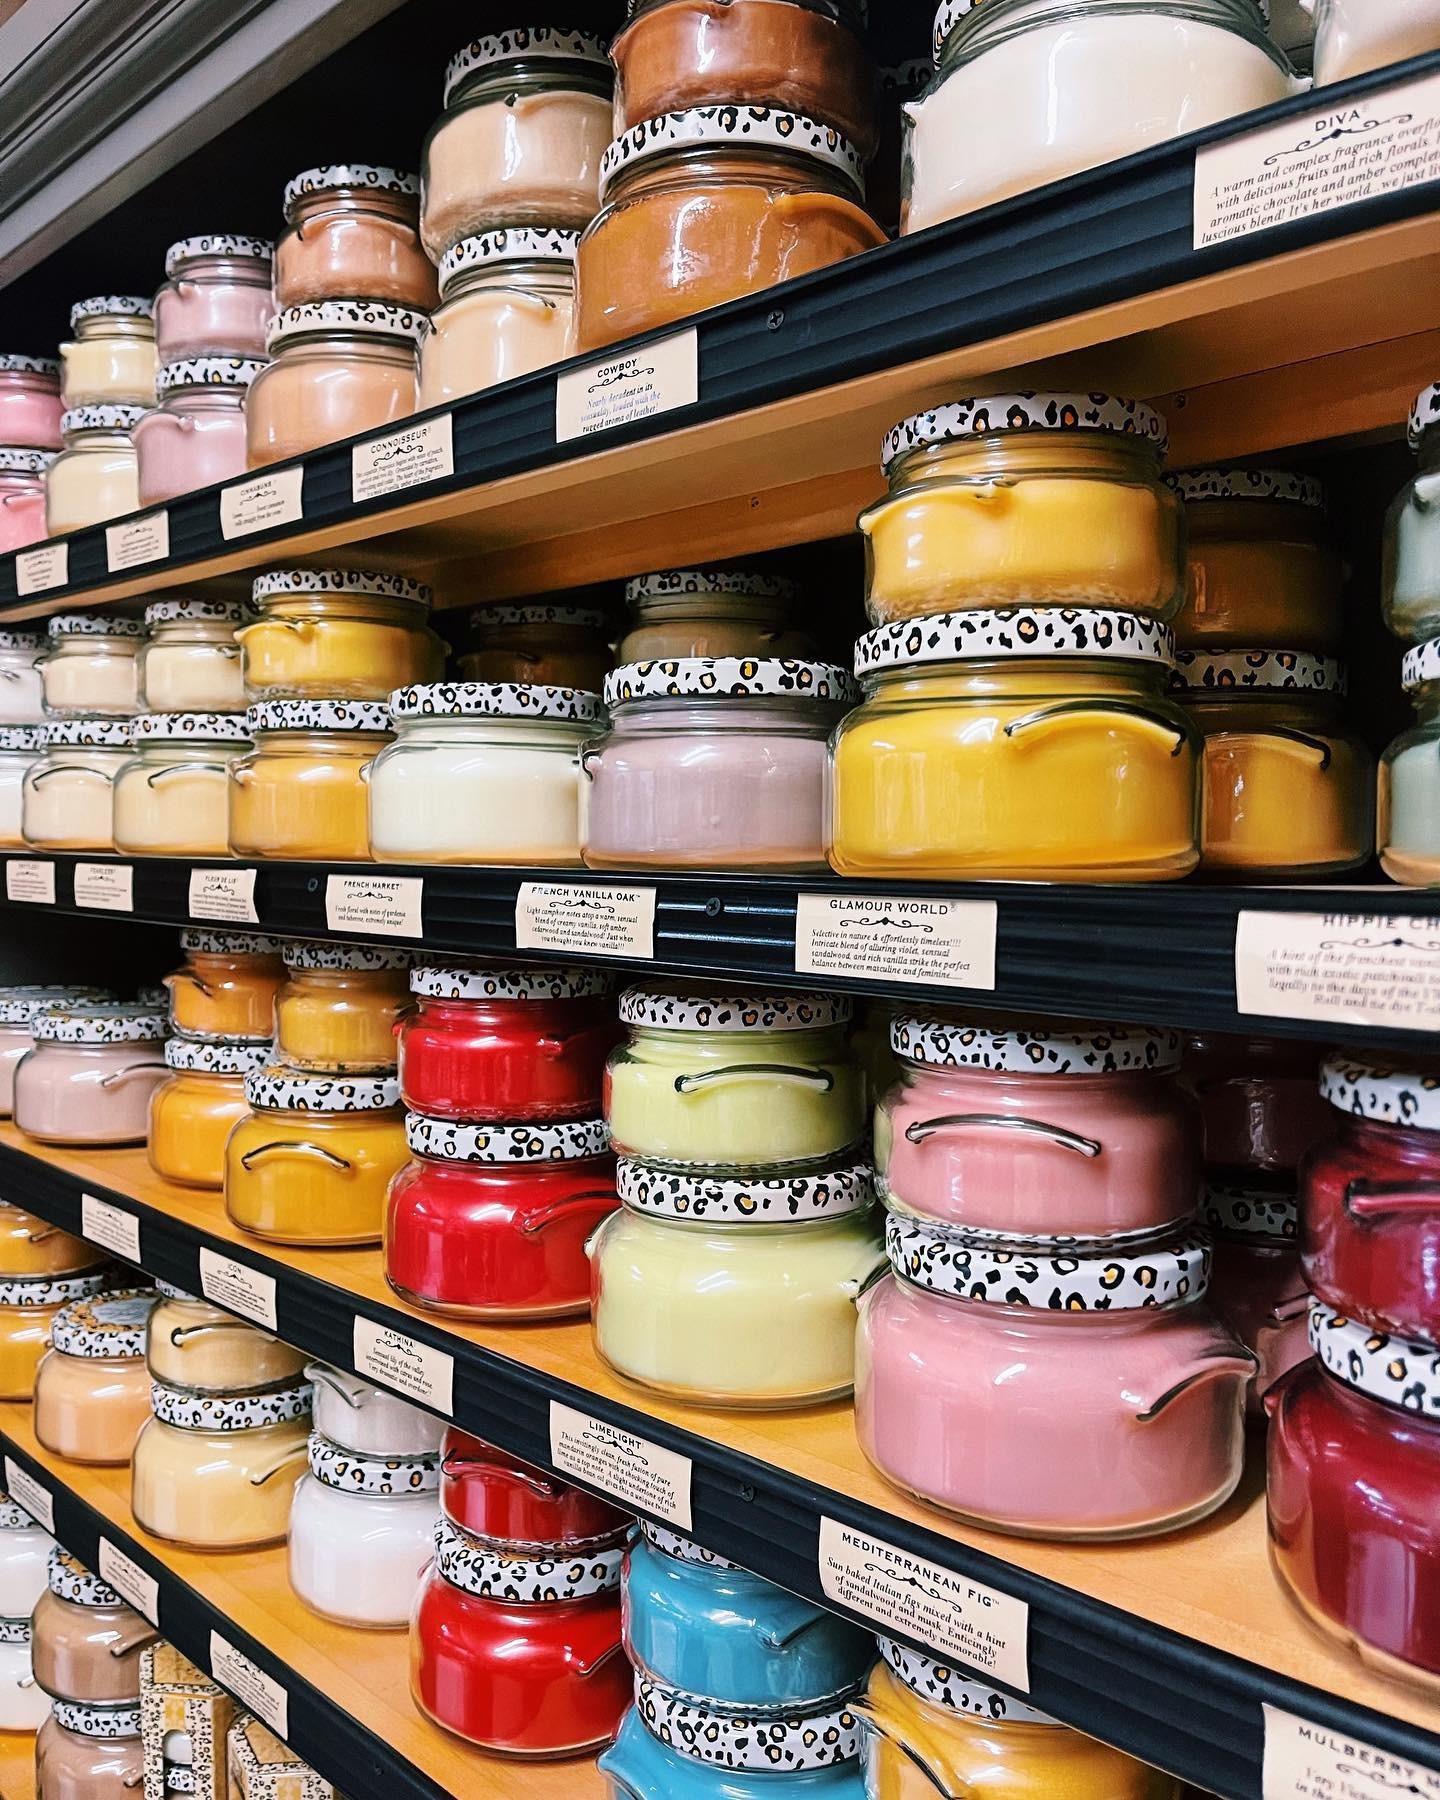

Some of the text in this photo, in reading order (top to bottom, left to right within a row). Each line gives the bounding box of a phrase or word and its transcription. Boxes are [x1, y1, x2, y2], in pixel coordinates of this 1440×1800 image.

[1315, 109, 1360, 132] DIVA
[1210, 186, 1219, 199] A
[1223, 178, 1254, 194] warm
[1257, 166, 1280, 183] and
[1282, 153, 1331, 175] complex
[1332, 134, 1394, 162] fragrance
[1217, 194, 1240, 210] with
[1244, 179, 1294, 202] delicious
[1296, 166, 1329, 188] fruits
[1332, 156, 1356, 174] and
[1359, 150, 1383, 167] rich
[1201, 169, 1425, 244] luscious blend! It's her just
[1210, 204, 1260, 228] aromatic
[1263, 186, 1319, 211] chocolate
[1321, 175, 1345, 193] and
[1347, 166, 1386, 185] amber
[597, 358, 637, 378] COWBOY
[626, 410, 634, 421] of
[370, 428, 427, 454] CONNOISSEUR
[343, 880, 400, 890] FRENCH MARKET
[531, 887, 569, 897] FRENCH
[573, 889, 613, 900] VANILLA
[829, 899, 949, 915] GLAMOUR WORLD
[535, 916, 549, 924] blend
[557, 920, 576, 928] creamy
[1321, 914, 1397, 929] HIPPIE
[532, 926, 559, 935] cedarwood
[619, 934, 634, 943] when
[551, 936, 572, 945] thought
[584, 939, 597, 947] knew
[811, 928, 840, 938] Selective
[848, 933, 871, 941] nature
[872, 933, 878, 941] &
[880, 934, 919, 946] effortlessly
[811, 938, 839, 948] Intricate
[839, 940, 859, 950] blend
[860, 942, 869, 952] of
[869, 943, 897, 955] alluring
[921, 948, 950, 957] sensual
[811, 959, 917, 976] balance between masculine and
[868, 954, 881, 963] rich
[883, 956, 908, 965] vanilla
[910, 957, 929, 967] strike
[930, 959, 942, 968] the
[943, 961, 971, 971] perfect
[384, 1330, 414, 1348] KATHINA
[562, 1431, 573, 1442] This
[590, 1420, 641, 1450] LIMELIGHT
[559, 1441, 584, 1457] mandarin
[586, 1453, 607, 1466] oranges
[582, 1467, 596, 1479] bean
[841, 1532, 961, 1593] MEDITERRANEAN
[827, 1556, 843, 1572] Sun
[845, 1565, 871, 1586] baked
[873, 1578, 902, 1600] Italian
[902, 1593, 920, 1610] figs
[923, 1604, 952, 1623] mixed
[954, 1618, 974, 1634] with
[986, 1631, 1006, 1649] hint
[835, 1575, 997, 1658] of sandalwood and musk. Enticingly
[837, 1586, 996, 1669] different and extremely memorable!
[1299, 1725, 1415, 1778] MULBERRY
